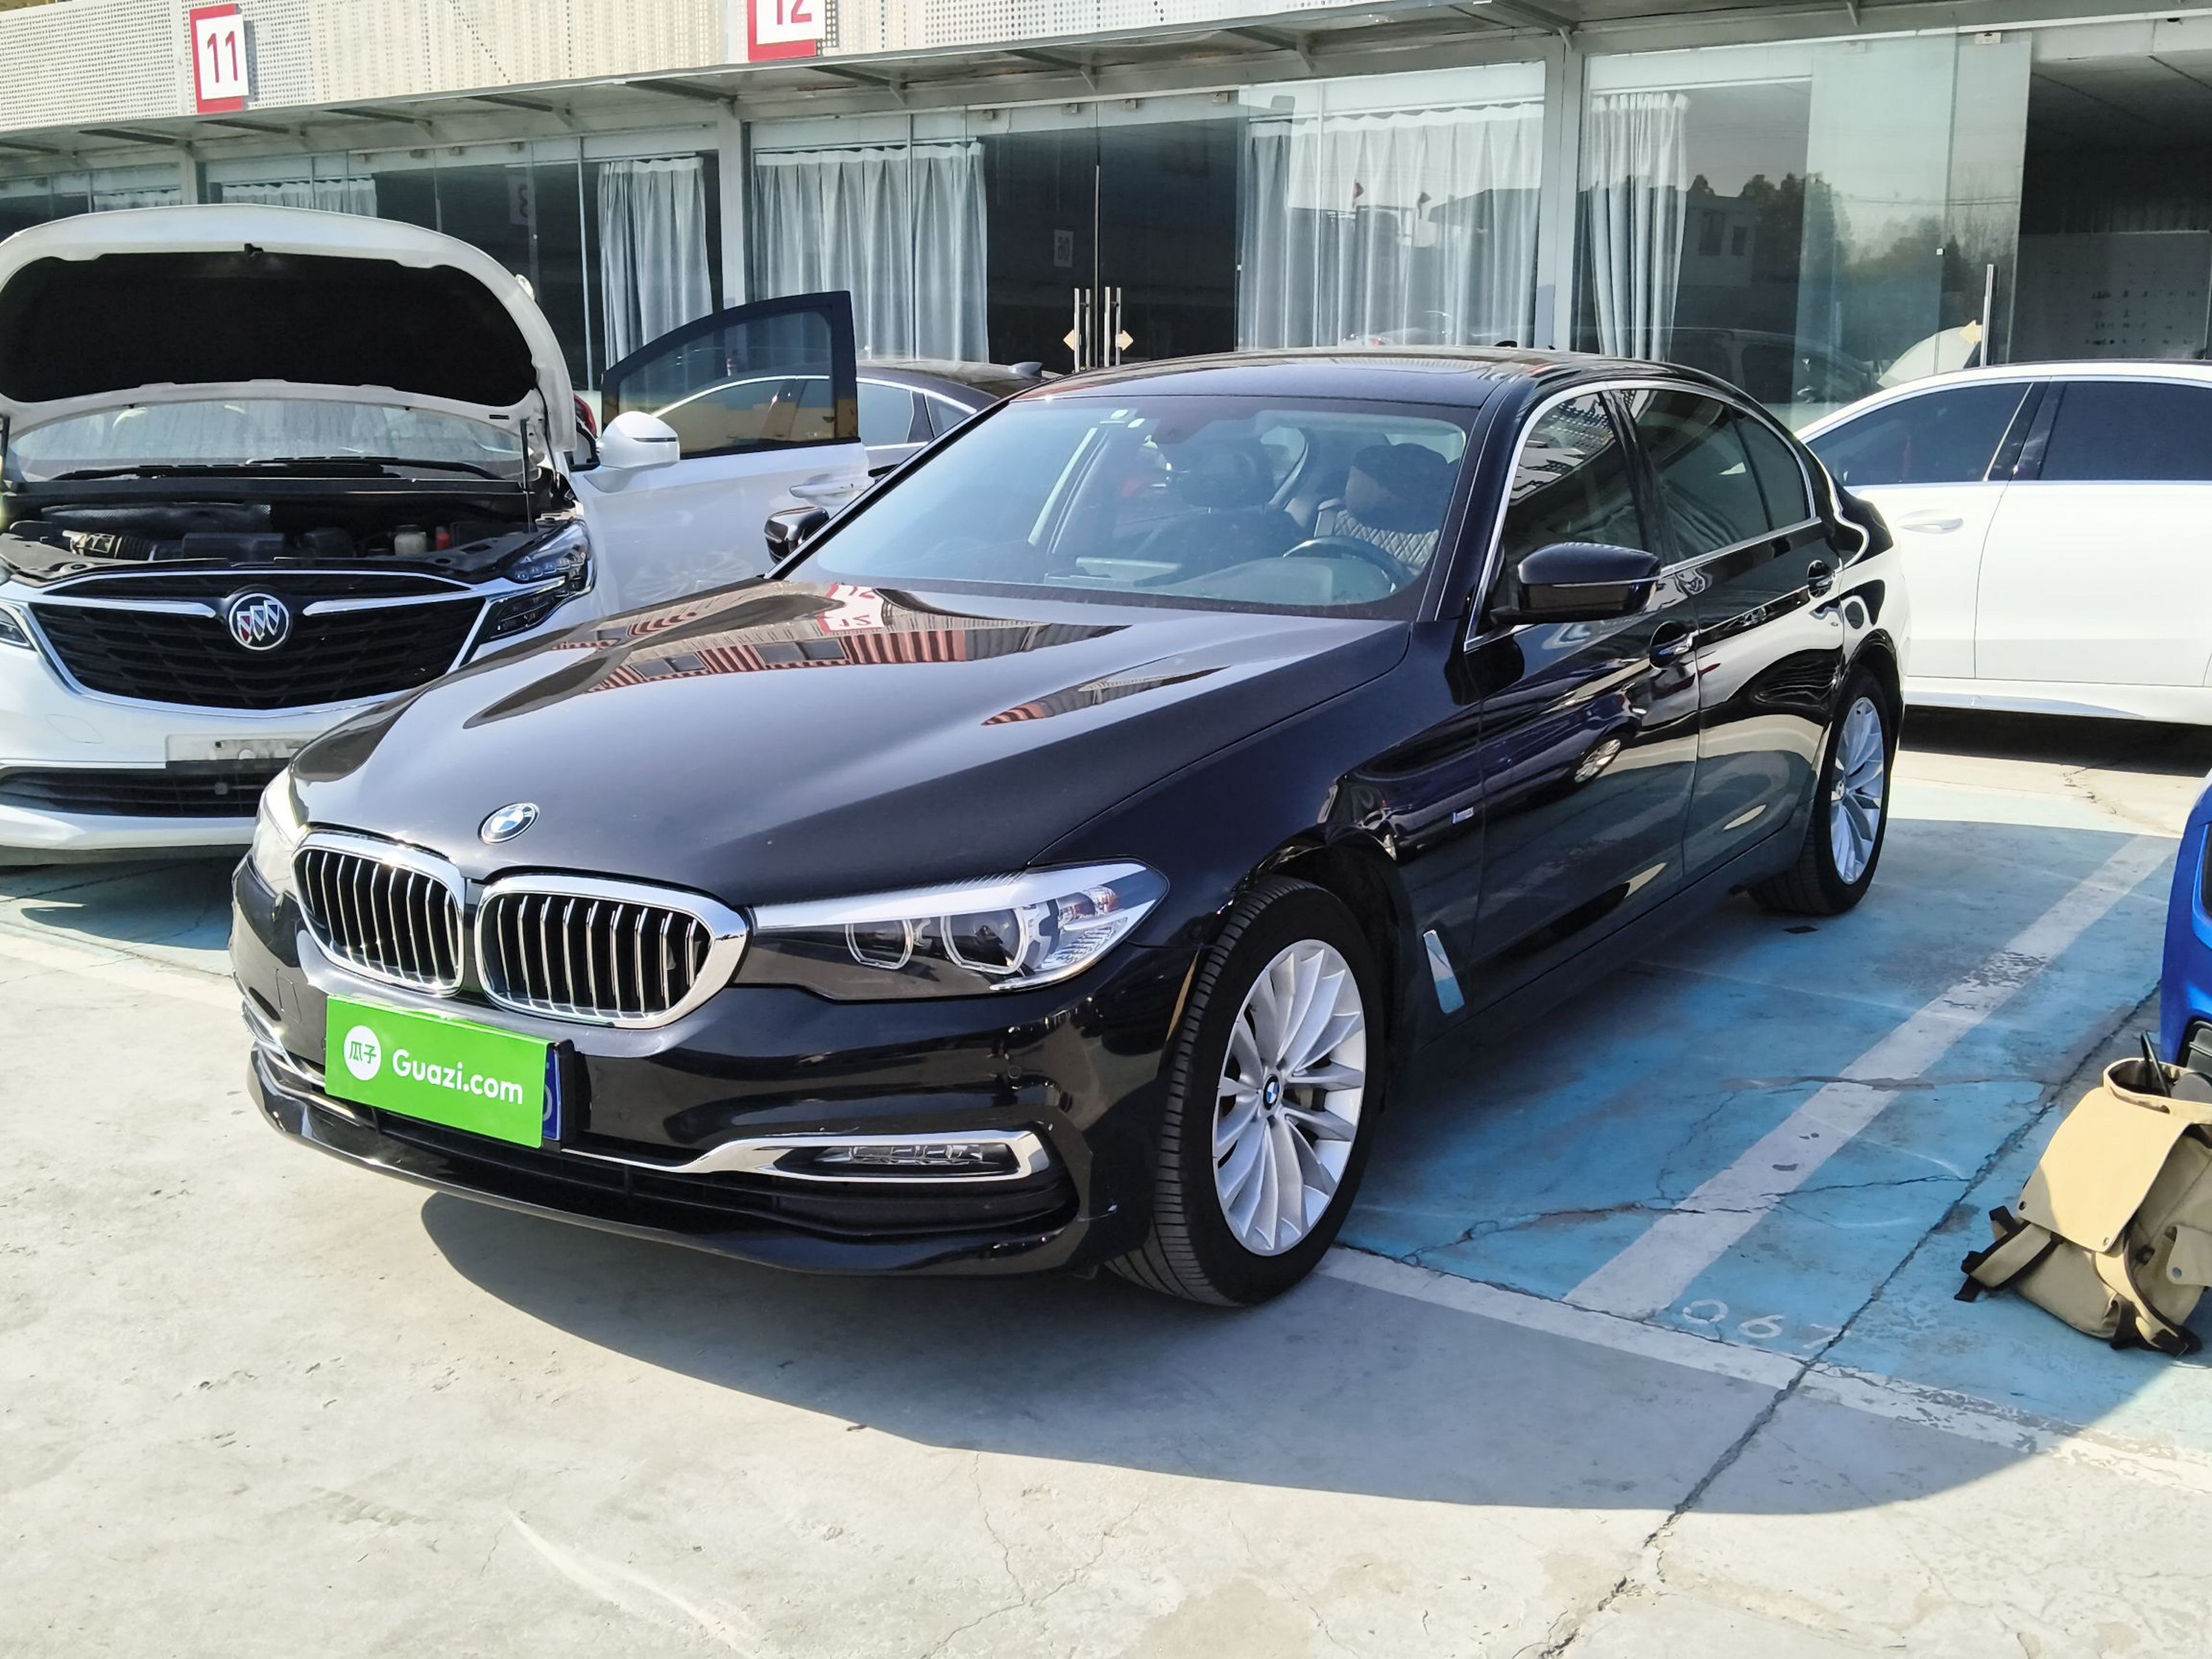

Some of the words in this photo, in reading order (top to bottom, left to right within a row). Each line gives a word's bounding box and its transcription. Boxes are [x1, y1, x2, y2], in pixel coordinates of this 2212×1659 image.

[207, 31, 238, 83] 11
[349, 1040, 377, 1065] 瓜子
[392, 1048, 523, 1105] Guazi.com
